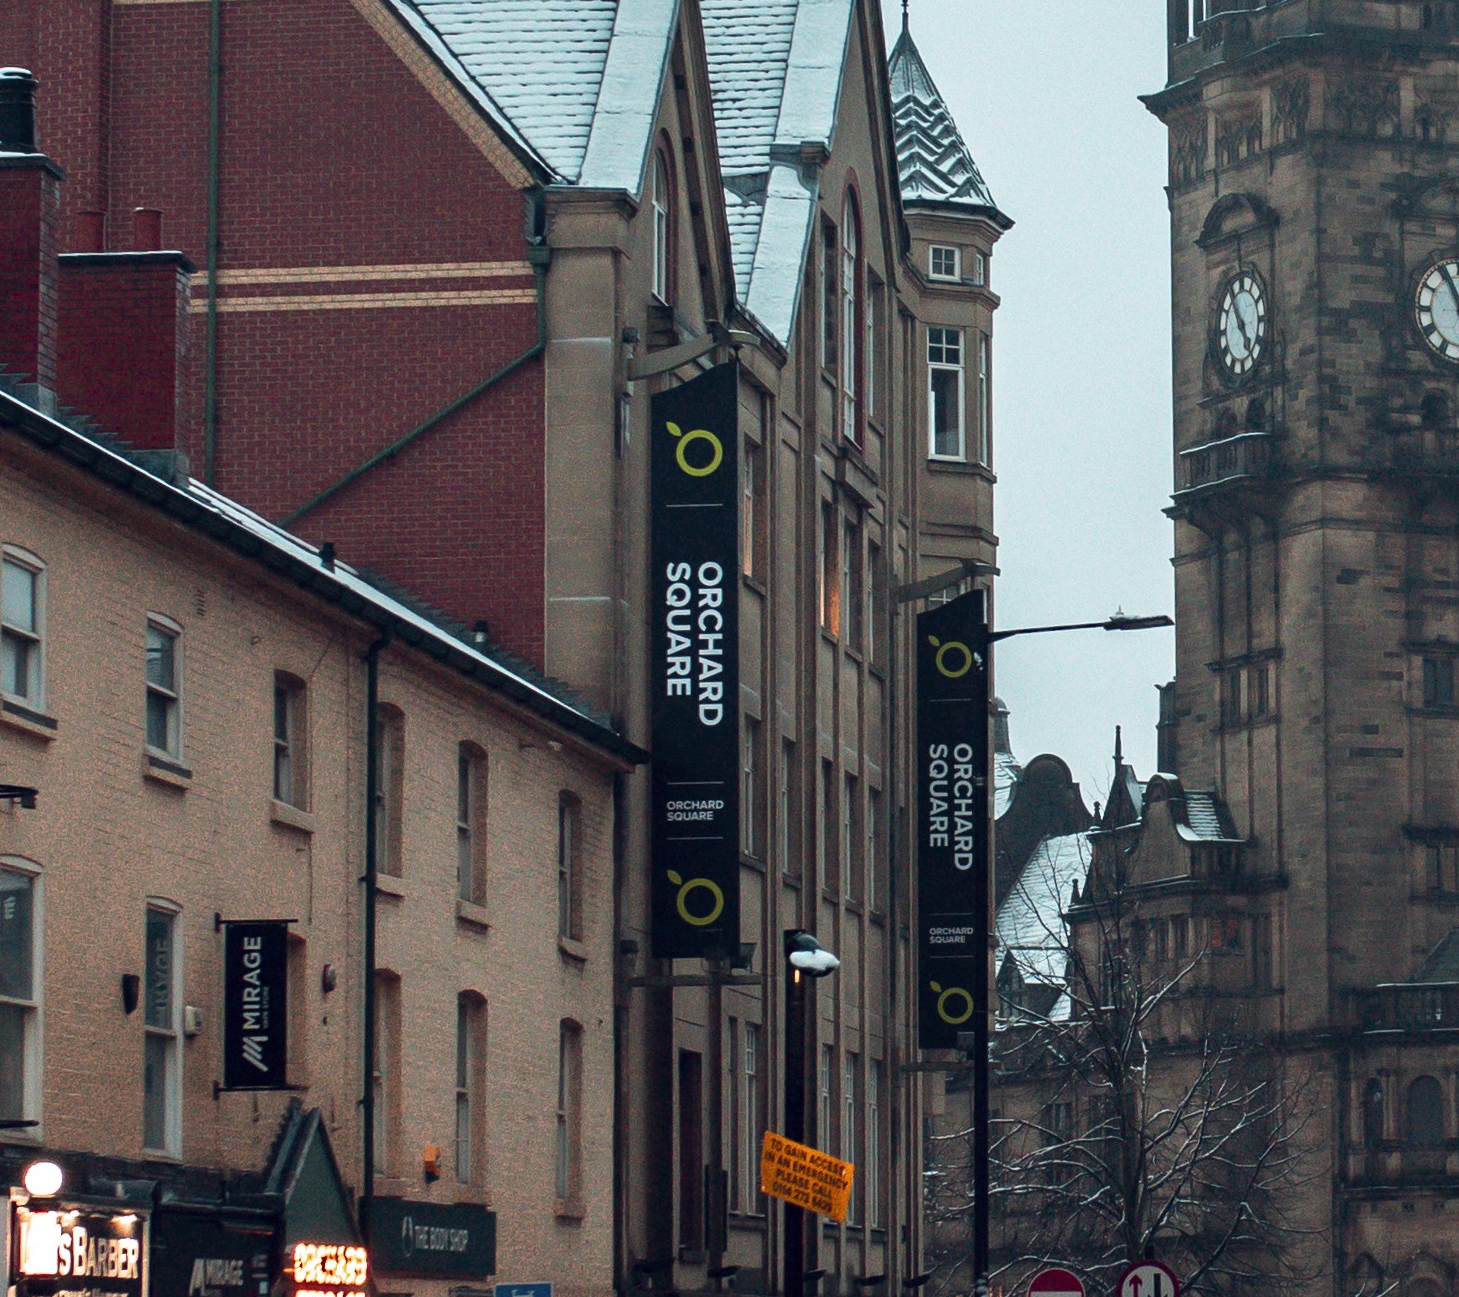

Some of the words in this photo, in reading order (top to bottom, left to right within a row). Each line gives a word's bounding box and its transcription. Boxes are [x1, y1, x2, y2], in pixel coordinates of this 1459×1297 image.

[666, 562, 692, 696] SQUARE
[698, 561, 723, 726] ORCHARD
[667, 800, 724, 810] ORCHARD
[929, 743, 948, 847] SQUARE
[953, 743, 973, 871] ORCHARD
[667, 811, 714, 821] SQUARE
[929, 927, 974, 935] ORCHARD
[243, 936, 261, 1030] MIRAGE
[770, 1138, 783, 1152] TO
[784, 1144, 807, 1162] GAIN
[809, 1155, 846, 1176] ACCESS
[777, 1155, 791, 1168] AN
[792, 1161, 848, 1190] EMERGENCY
[775, 1168, 810, 1190] PLEASE
[812, 1182, 832, 1199] CALL
[72, 1226, 139, 1279] BARBER
[415, 1226, 429, 1249] THE
[430, 1226, 449, 1251] BODY
[450, 1228, 469, 1252] SHOP
[205, 1258, 243, 1286] MIRAGE
